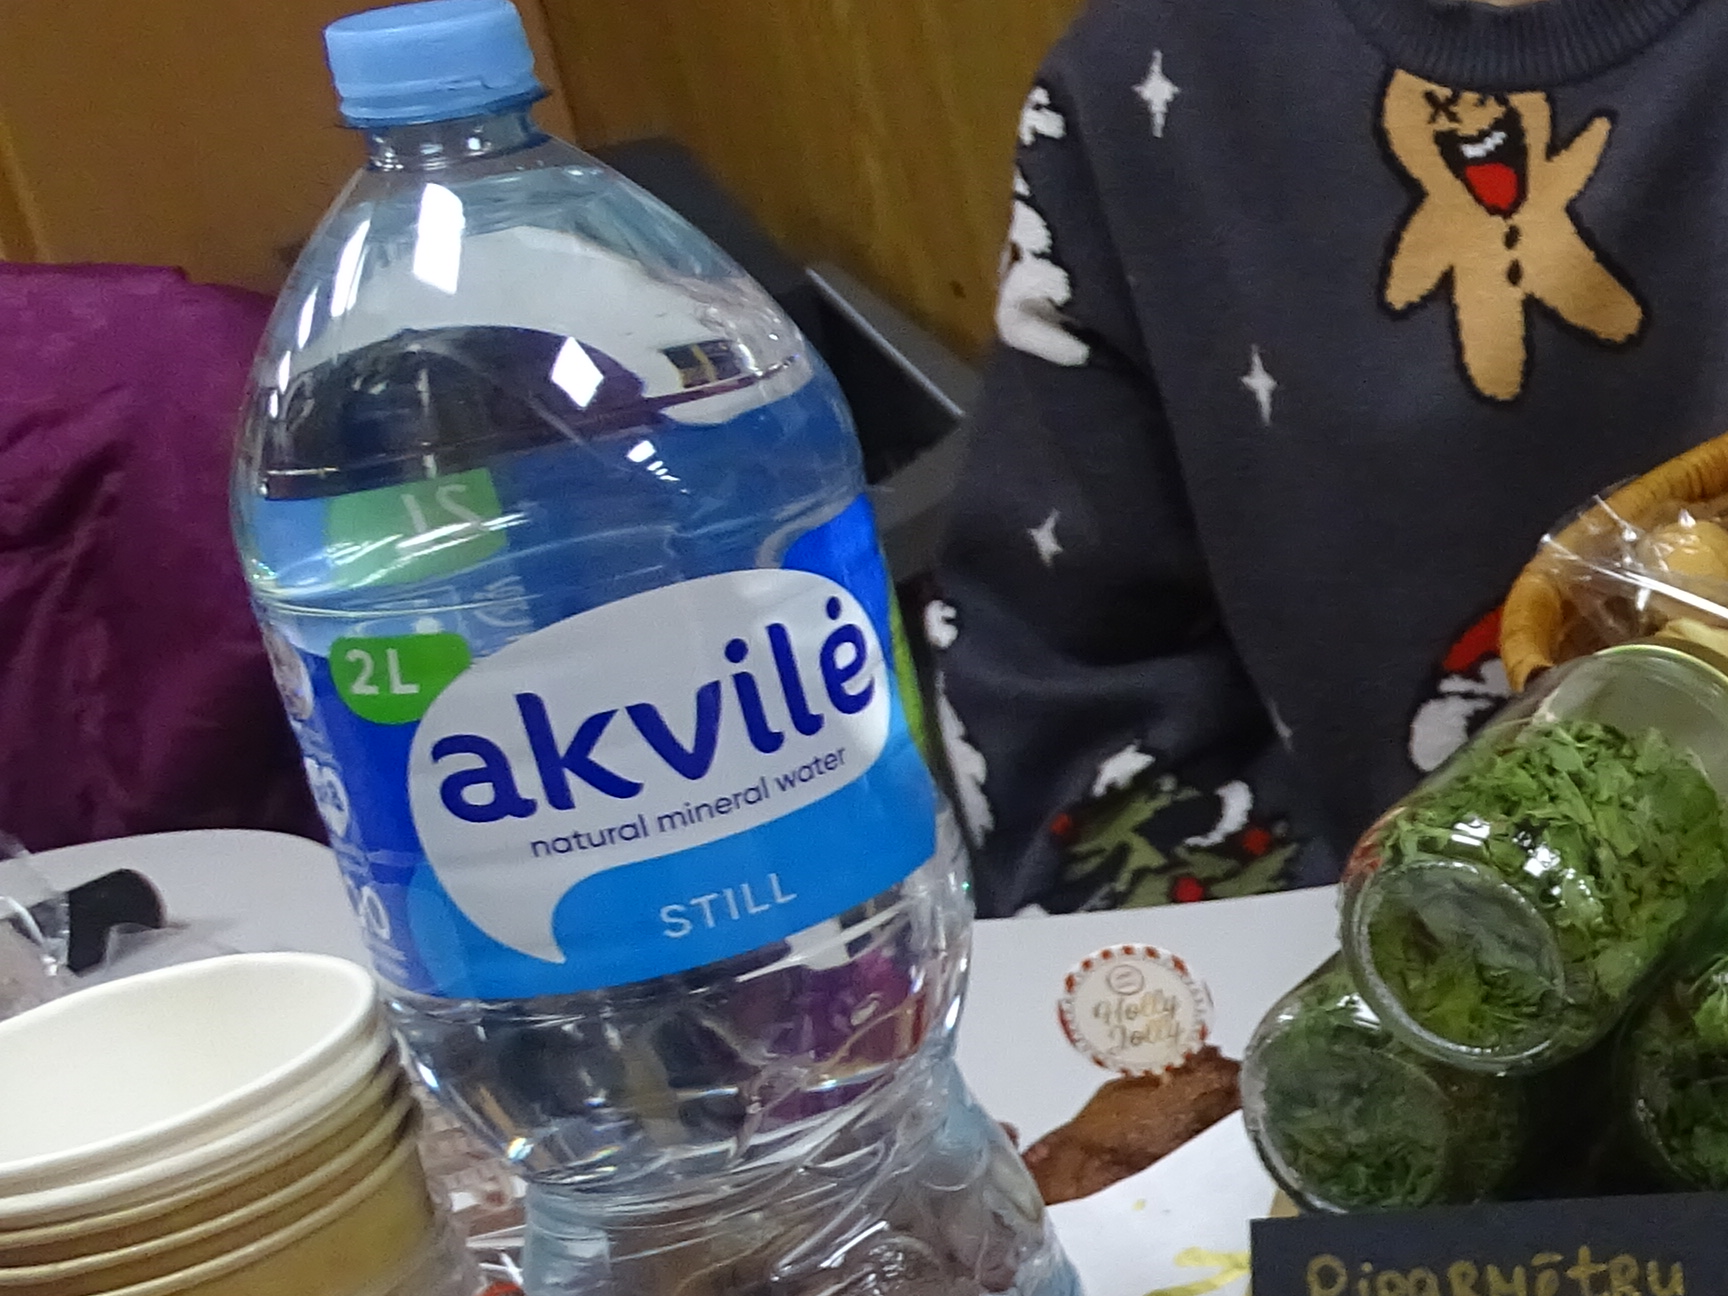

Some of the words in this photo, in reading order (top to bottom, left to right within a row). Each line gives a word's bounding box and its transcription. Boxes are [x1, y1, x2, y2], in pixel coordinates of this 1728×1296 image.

[430, 596, 876, 824] akvilė
[530, 814, 650, 857] natural
[658, 784, 771, 835] mineral
[774, 746, 847, 794] water
[660, 874, 798, 939] STILL
